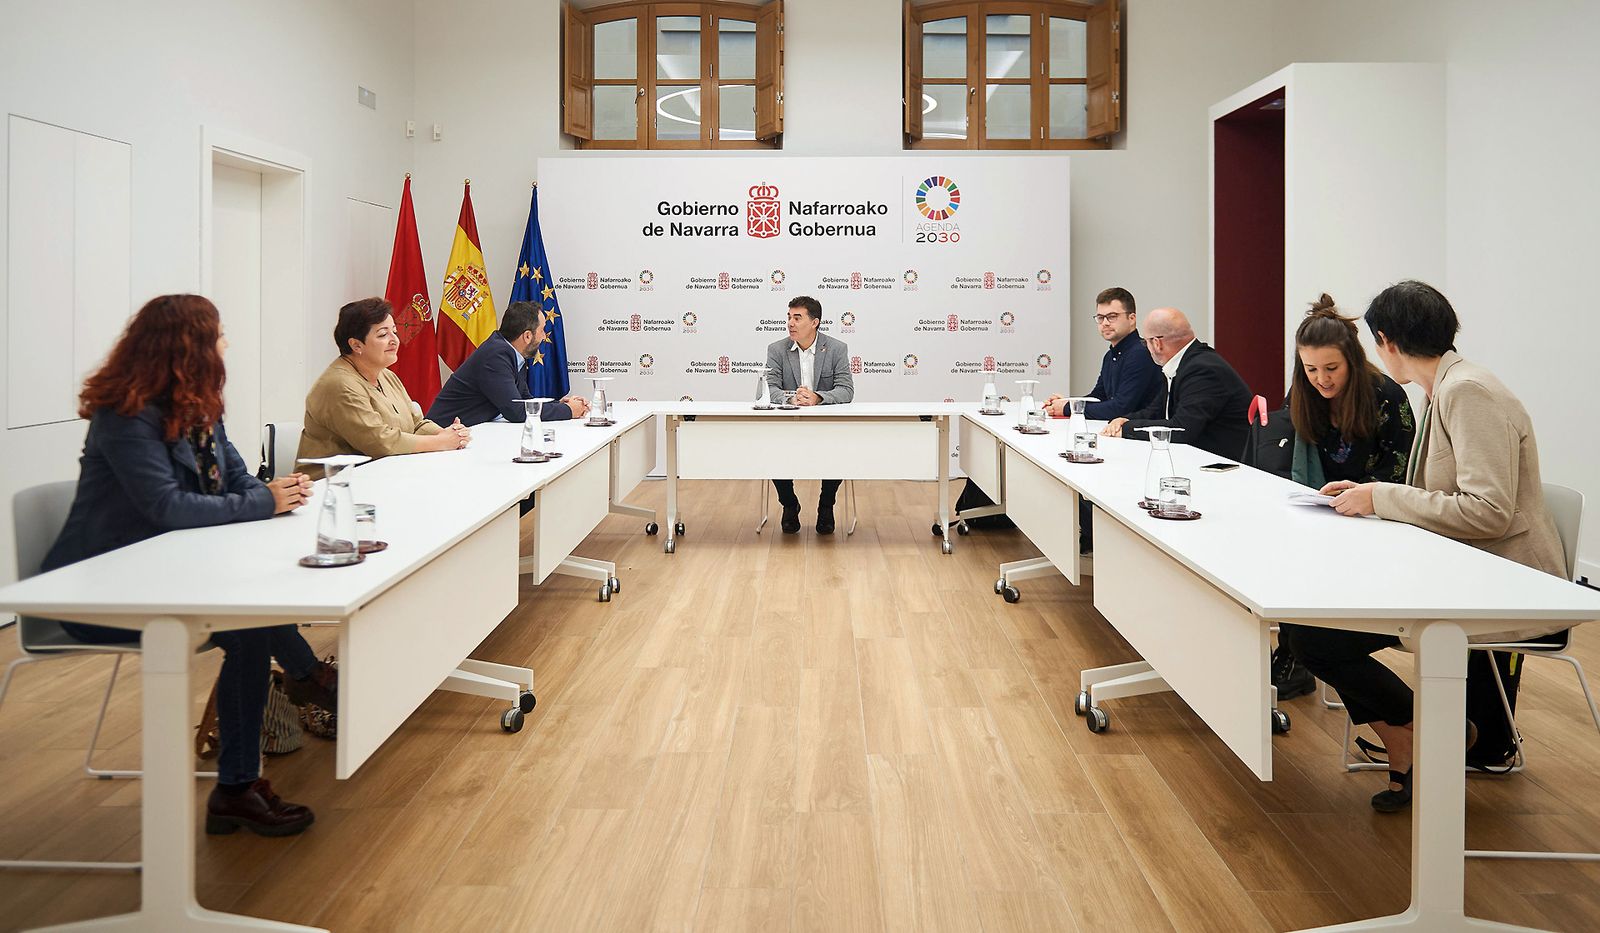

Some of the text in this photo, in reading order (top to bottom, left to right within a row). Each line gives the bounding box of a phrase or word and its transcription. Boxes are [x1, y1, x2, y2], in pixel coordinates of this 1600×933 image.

[657, 201, 739, 216] Gobierno
[788, 201, 888, 216] Nafarroako
[642, 222, 739, 237] de Navarra
[788, 222, 876, 237] Gobernua
[916, 222, 960, 231] AGENDA
[916, 232, 960, 243] 2030
